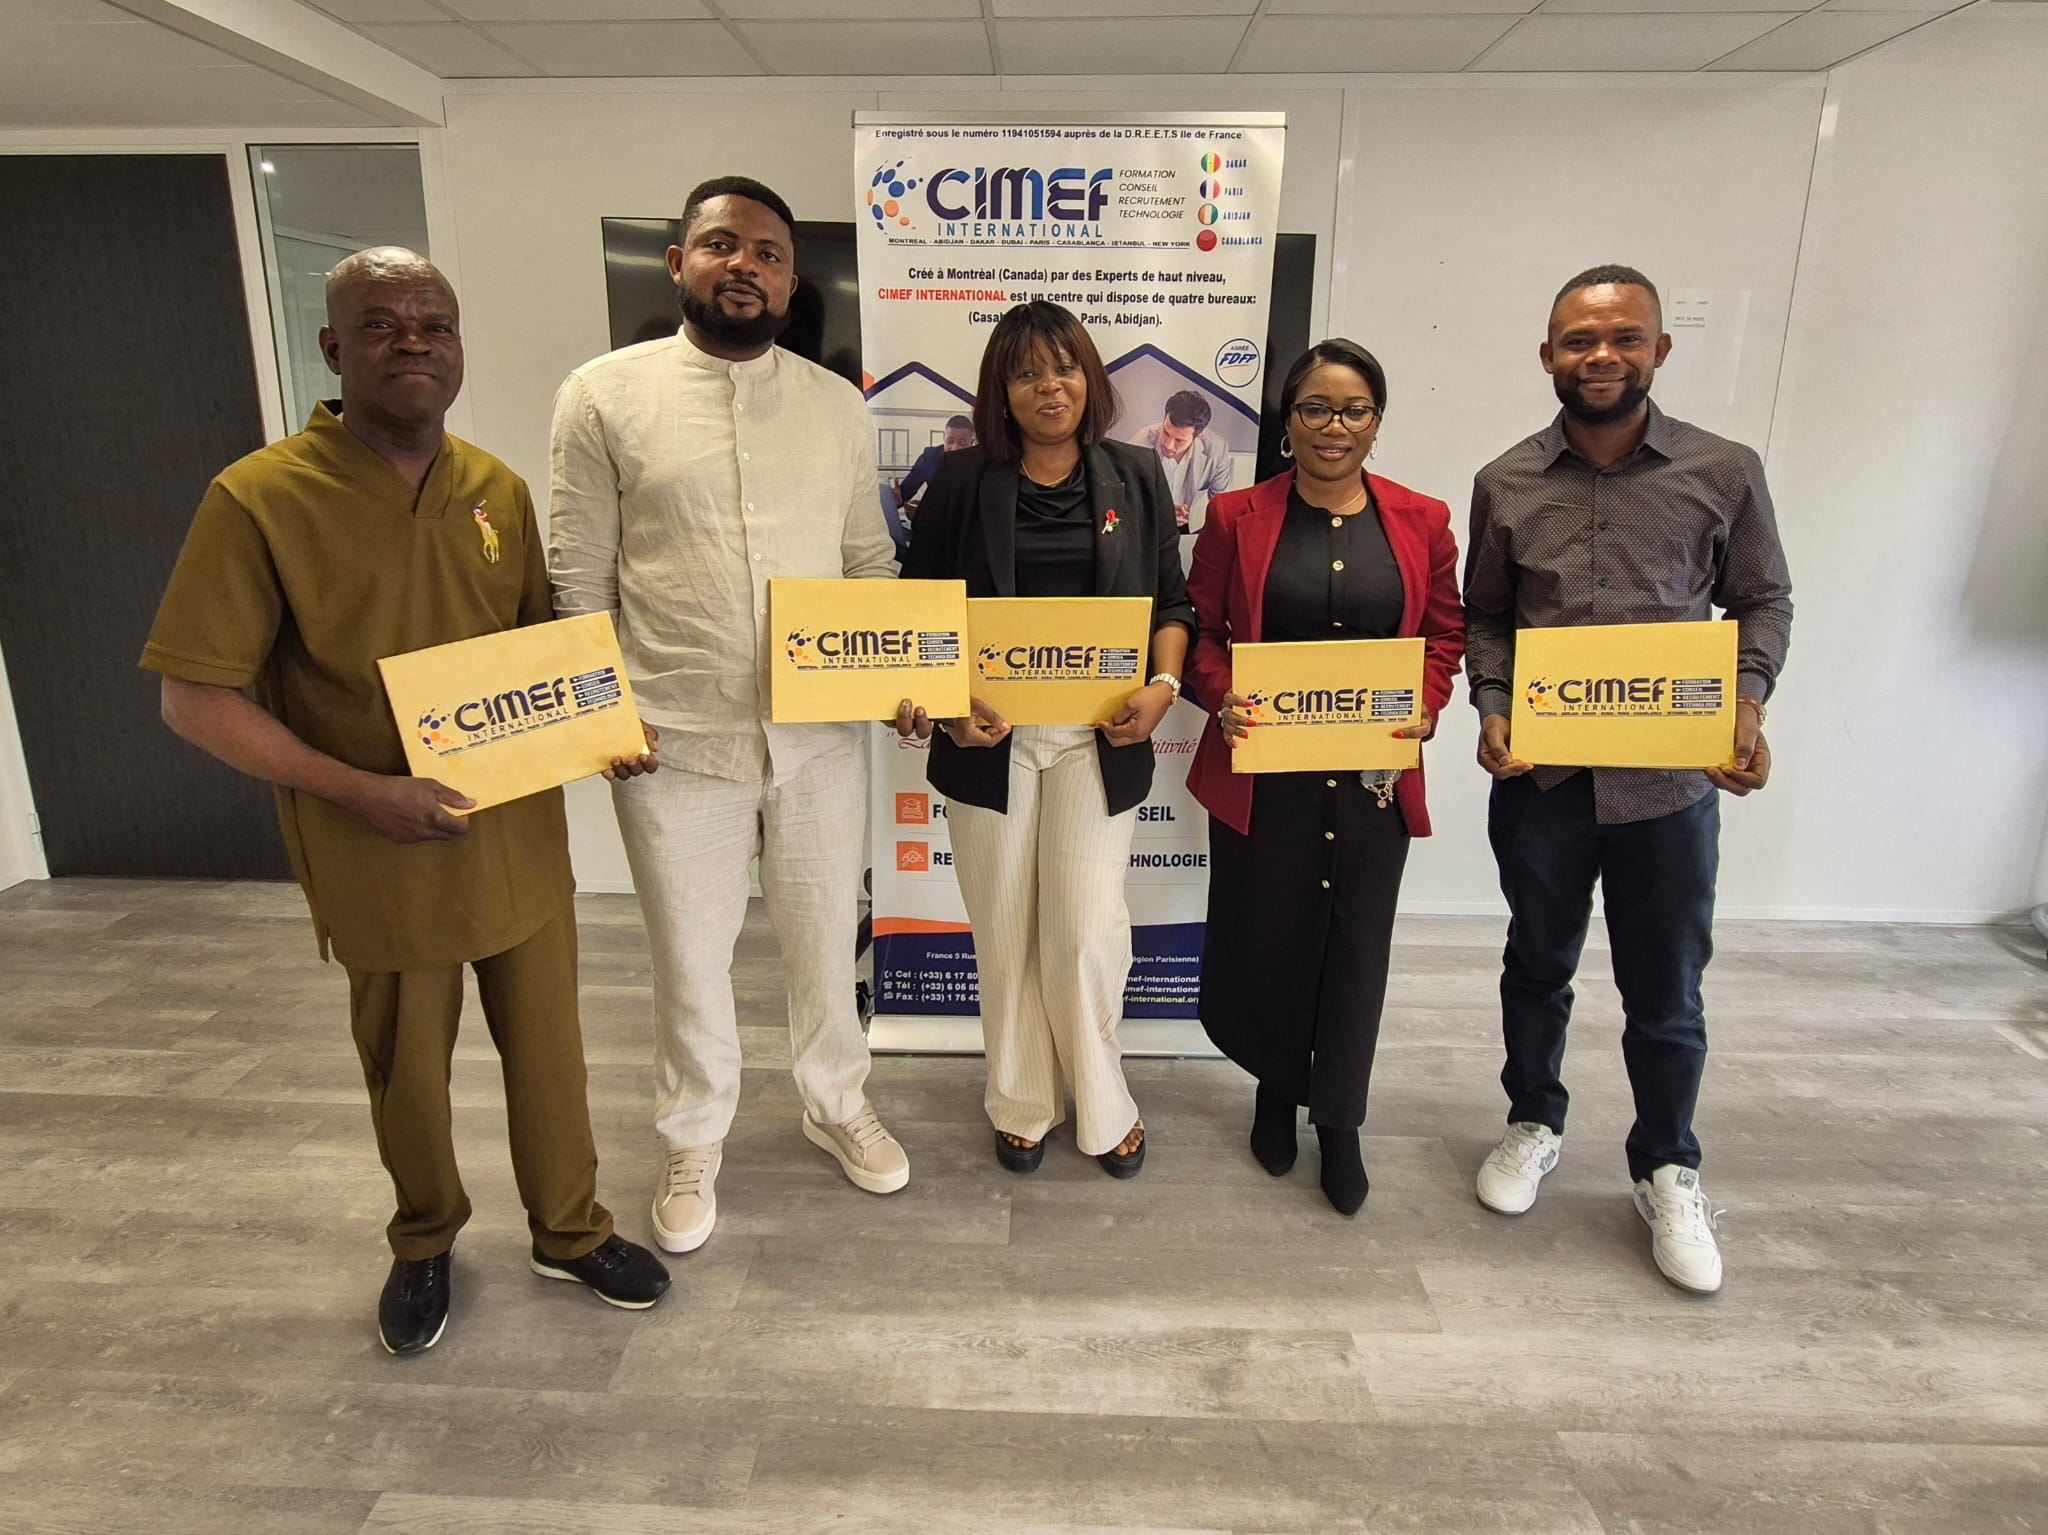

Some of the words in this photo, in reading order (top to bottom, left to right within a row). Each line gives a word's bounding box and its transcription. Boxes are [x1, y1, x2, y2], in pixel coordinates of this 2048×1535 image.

[876, 129, 924, 139] Enregistré
[926, 130, 949, 138] sous
[952, 129, 960, 138] le
[963, 129, 999, 138] numéro
[1002, 129, 1062, 138] 11941051594
[1064, 130, 1096, 140] auprès
[1100, 130, 1111, 138] de
[1114, 130, 1122, 138] la
[1125, 130, 1178, 139] D.R.E.E.T.S
[1194, 130, 1206, 139] de
[1209, 130, 1242, 140] France
[1119, 170, 1176, 178] FORMATION
[1119, 184, 1158, 192] CONSEIL
[1224, 188, 1243, 196] PARIS
[1118, 197, 1186, 206] RECRUTEMENT
[1119, 210, 1184, 219] TECHNOLOGIE
[938, 223, 1103, 238] INTERNATIONAL
[908, 267, 934, 280] Créé
[938, 268, 944, 279] à
[998, 268, 1048, 283] (Canada)
[1051, 272, 1069, 284] par
[1072, 270, 1092, 281] des
[1095, 270, 1138, 284] Experts
[1142, 270, 1154, 282] de
[1158, 270, 1182, 282] haut
[1186, 271, 1226, 285] niveau,
[878, 288, 912, 300] CIMEF
[916, 289, 1007, 301] INTERNATIONAL
[1010, 292, 1027, 302] est
[1031, 293, 1044, 302] un
[1048, 292, 1083, 303] centre
[1086, 292, 1104, 306] qui
[1106, 292, 1148, 306] dispose
[1152, 293, 1165, 304] de
[1168, 294, 1204, 306] quatre
[1208, 294, 1256, 304] bureaux:
[1080, 313, 1112, 326] Paris,
[1114, 313, 1162, 327] Abidjan).
[1219, 352, 1258, 366] FDFP
[824, 656, 911, 664] INTERNATIONAL
[1564, 704, 1662, 712] INTERNATIONAL
[1278, 712, 1363, 721] INTERNATIONAL
[467, 708, 570, 742] INTERNATIONAL
[926, 952, 952, 960] France
[954, 952, 960, 960] 5
[1156, 956, 1200, 964] Parisienne)
[920, 971, 943, 982] (+33)
[945, 972, 952, 980] 6
[954, 972, 964, 980] 17
[896, 982, 911, 990] Tél
[922, 982, 945, 992] (+33)
[896, 992, 914, 1000] Fax
[922, 994, 945, 1004] (+33)
